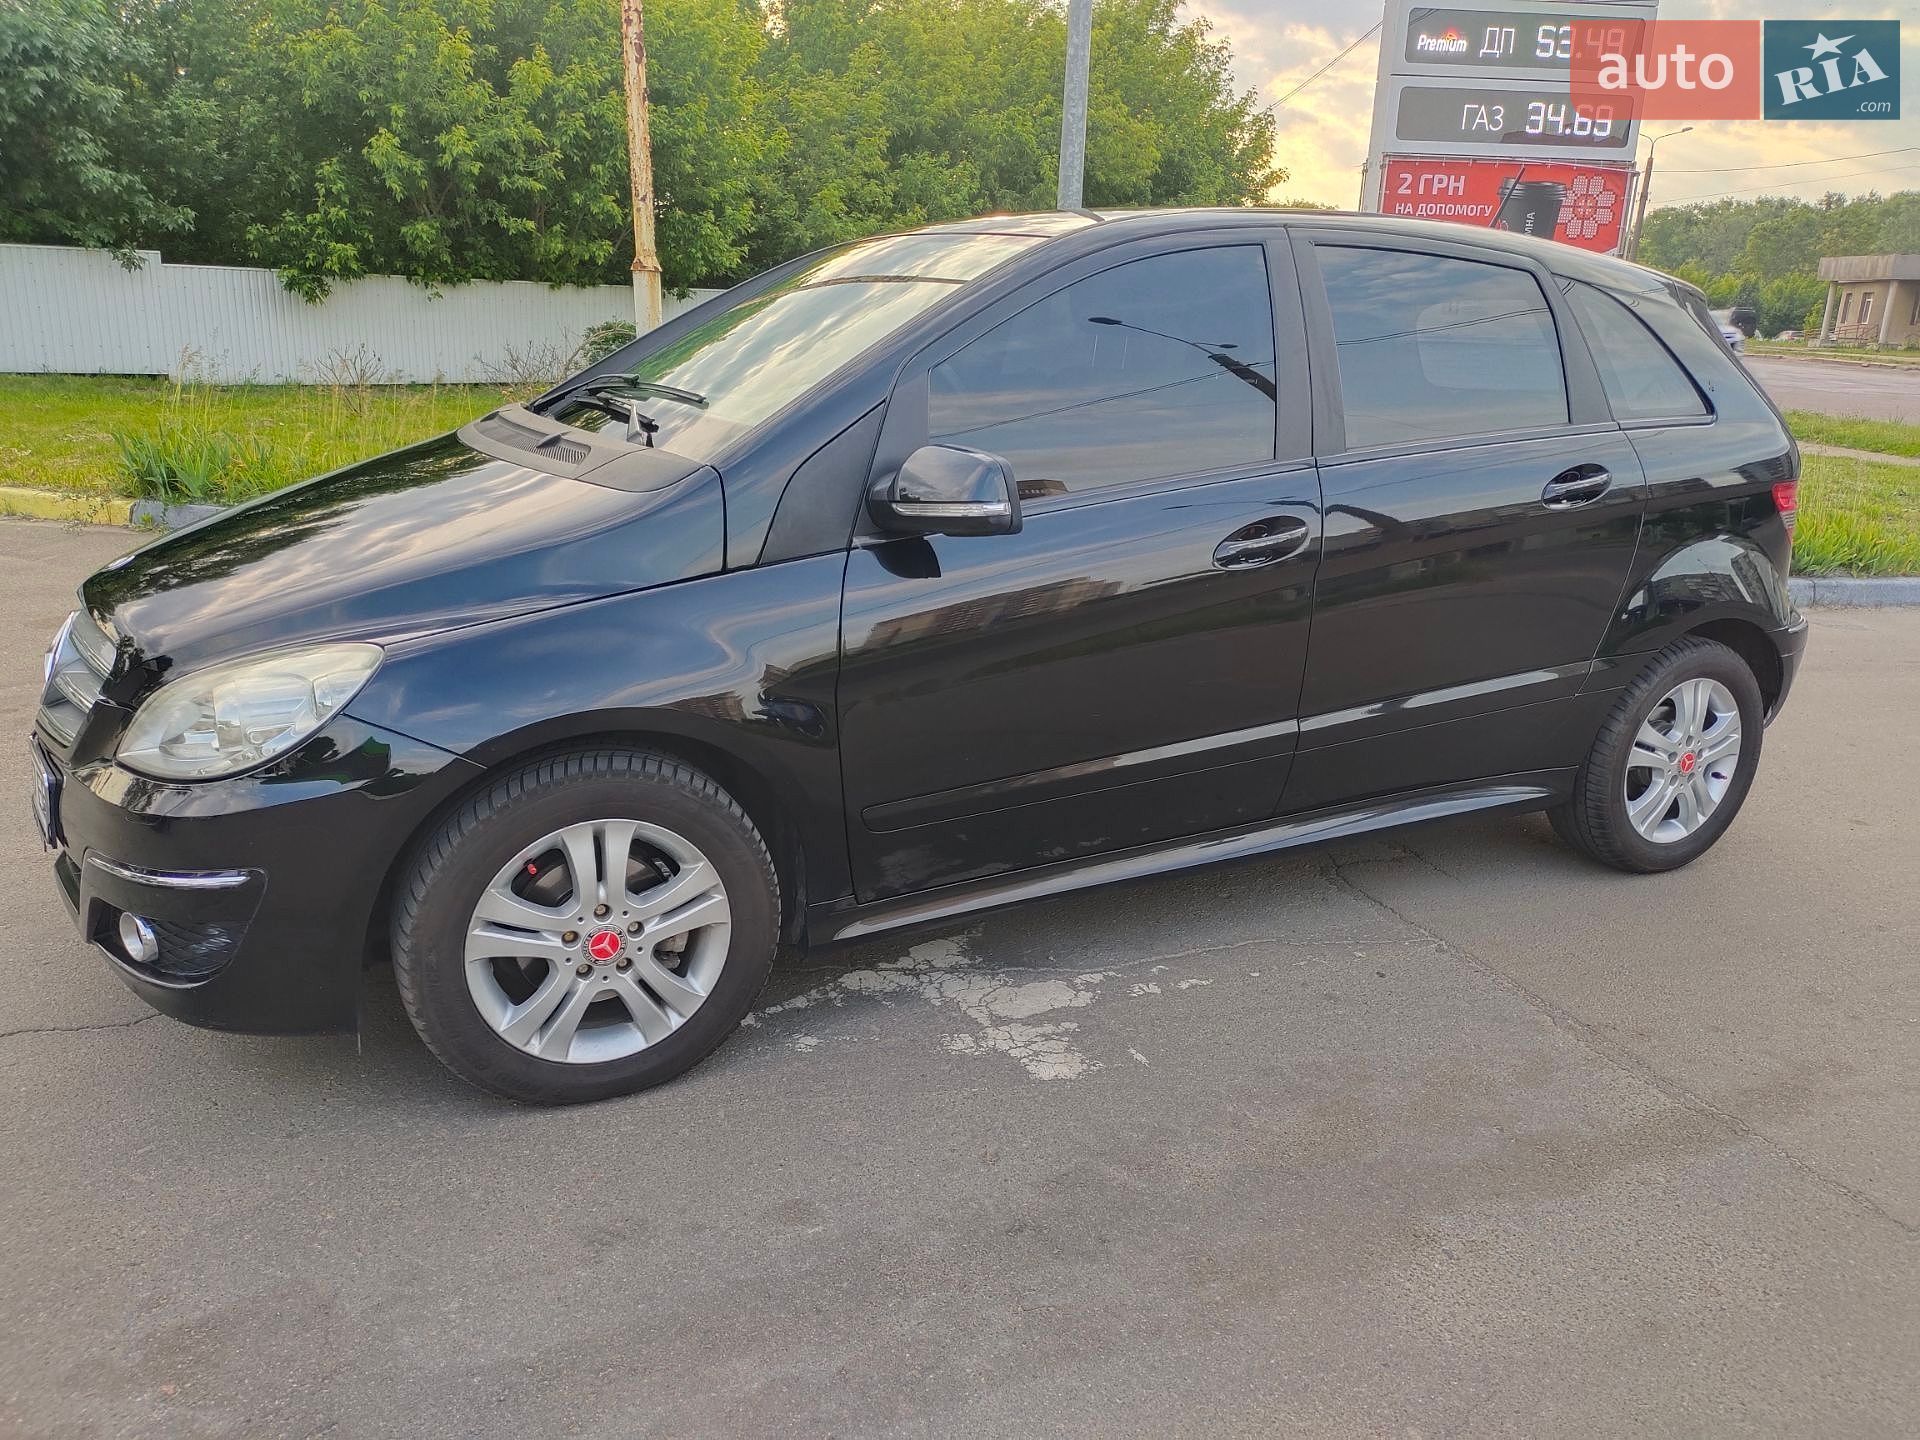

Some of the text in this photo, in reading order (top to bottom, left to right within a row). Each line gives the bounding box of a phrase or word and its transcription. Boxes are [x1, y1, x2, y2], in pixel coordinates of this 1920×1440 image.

[1417, 34, 1467, 52] Premium
[1479, 25, 1625, 58] ДП 53.49
[1461, 102, 1614, 136] ГАЗ 34.69
[1396, 173, 1465, 196] 2 ГРН
[1395, 203, 1493, 217] НА ДОПОМОГУ
